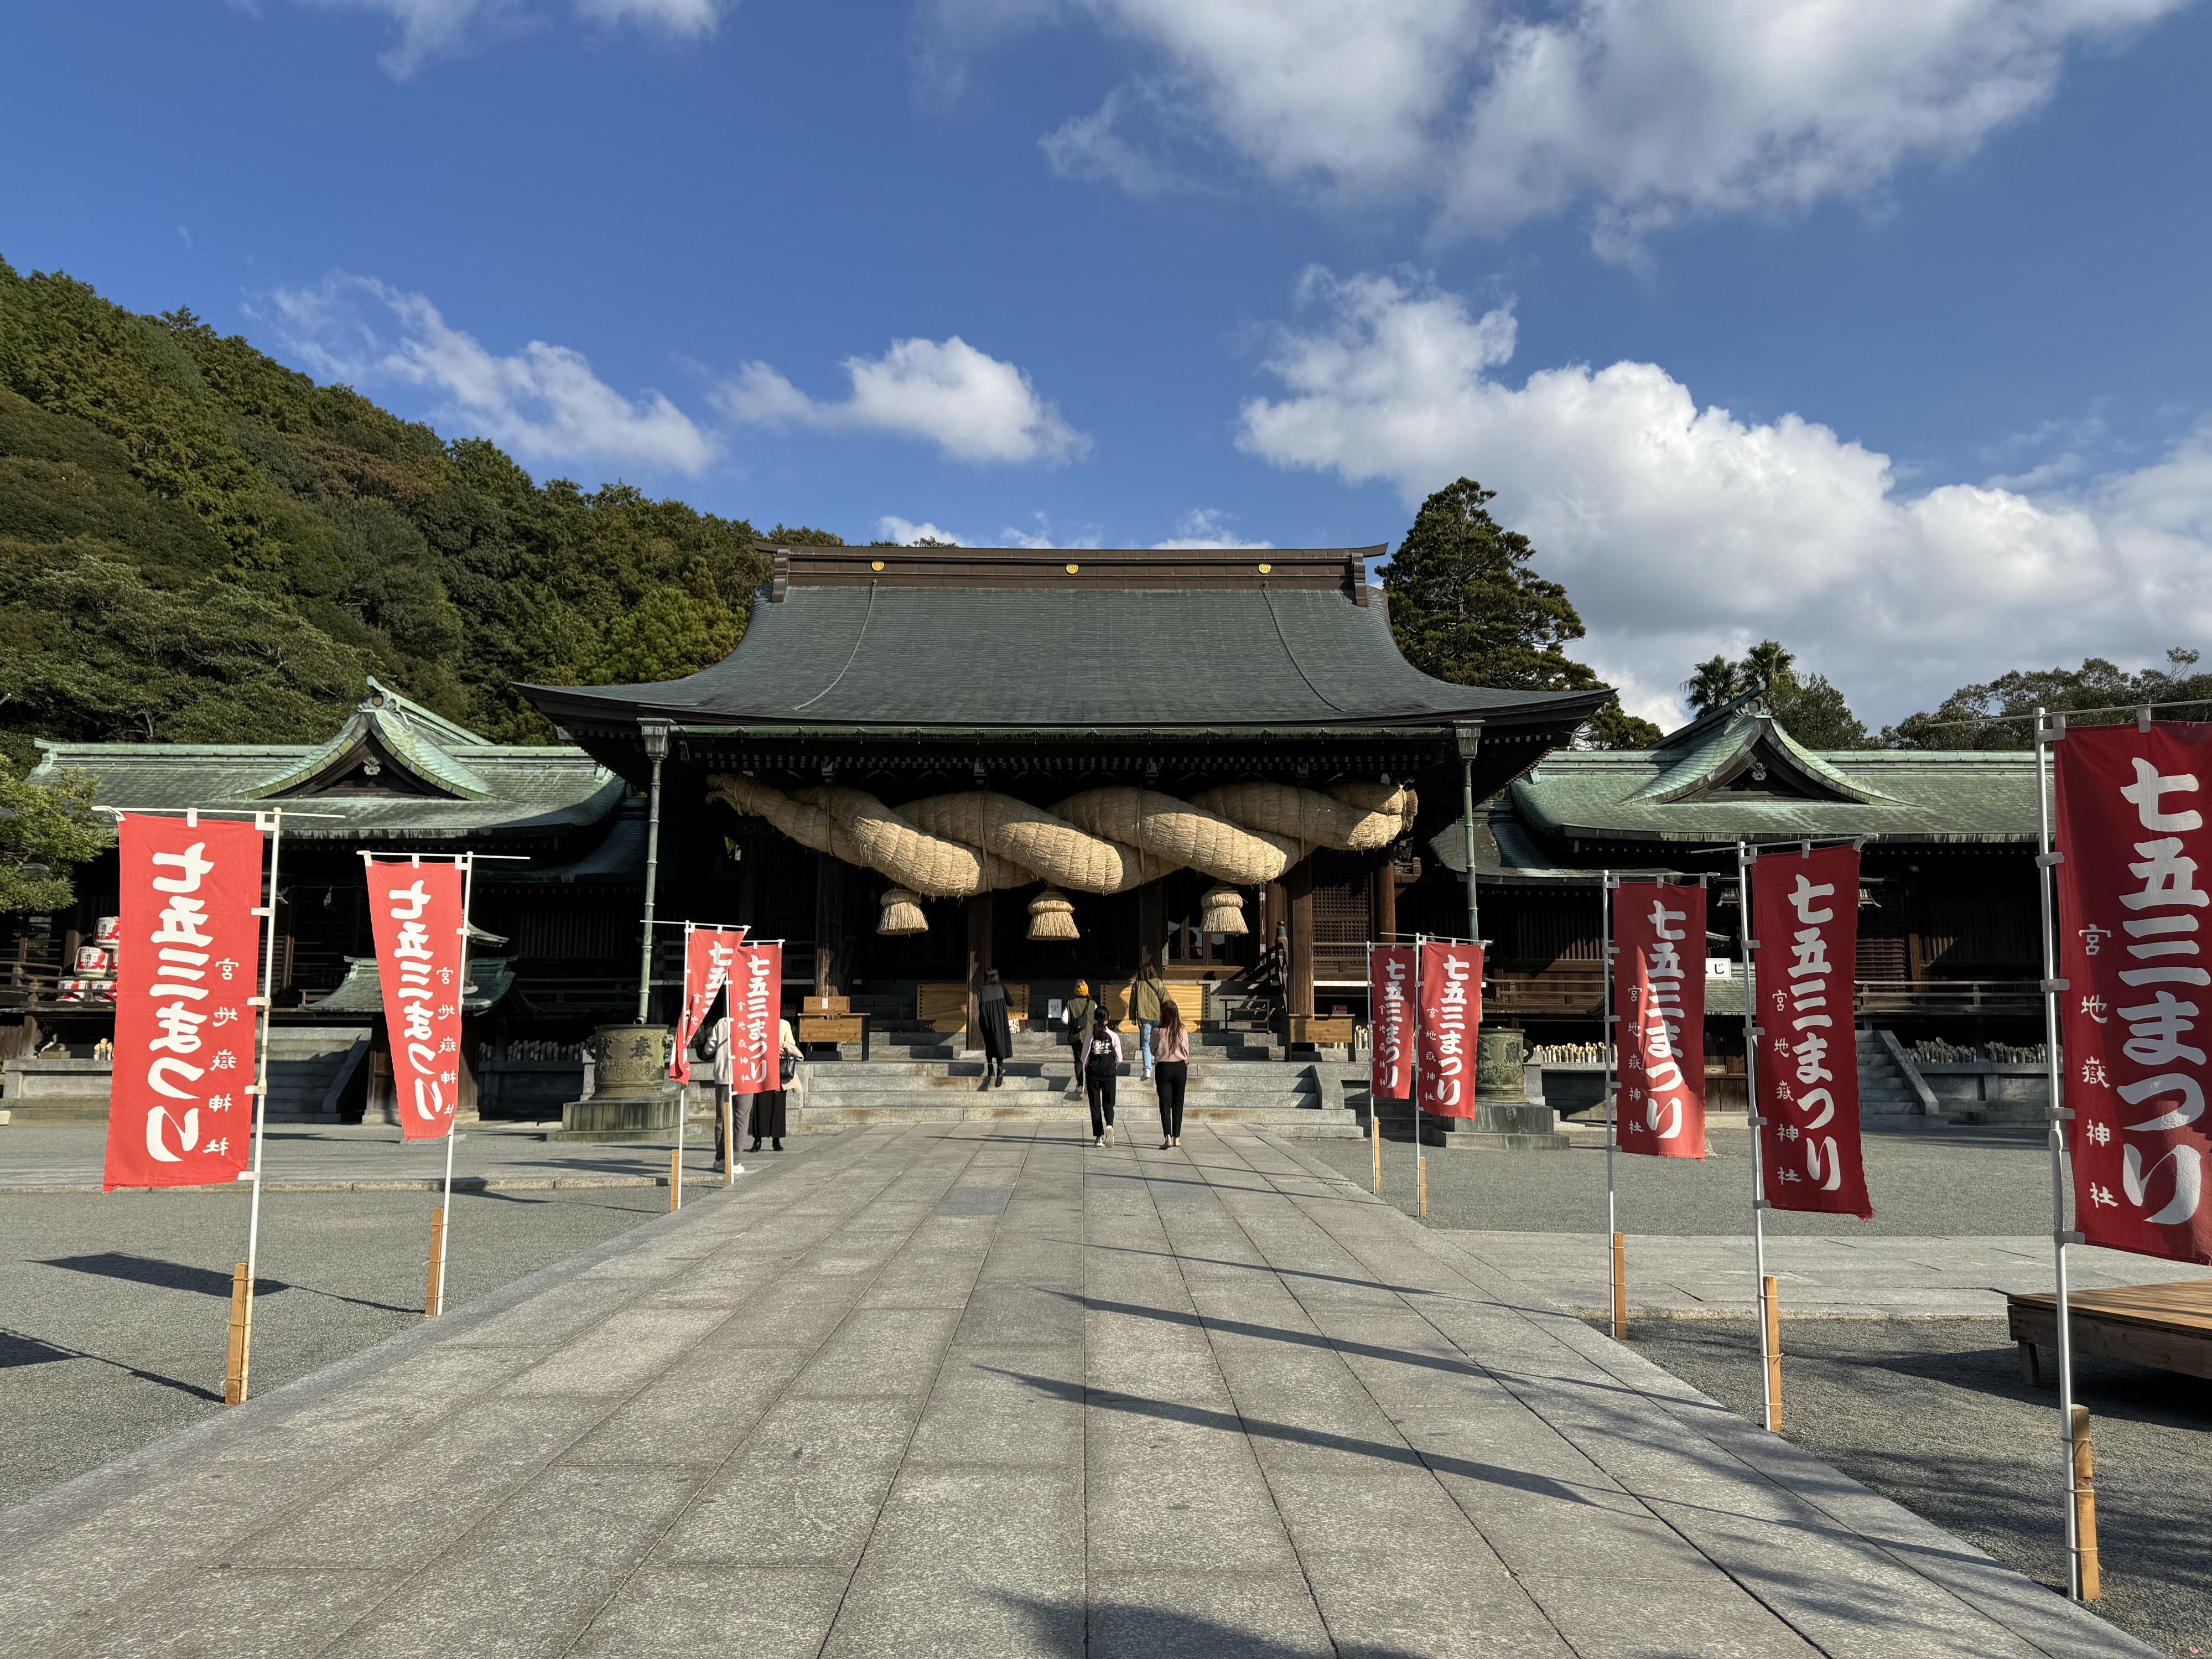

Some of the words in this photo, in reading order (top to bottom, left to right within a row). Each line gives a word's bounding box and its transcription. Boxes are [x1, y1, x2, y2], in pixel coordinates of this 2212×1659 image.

[746, 954, 770, 1083] 七五三まつり
[1384, 957, 1405, 1088] 七五三まつり
[1425, 1007, 1439, 1101] 宮地嶽神社
[1437, 953, 1470, 1106] 七五三まつり
[1627, 985, 1643, 1134] 宮地嶽神社
[1644, 899, 1687, 1139] 七五三まつり
[1787, 874, 1842, 1190] 七五三まつり
[2078, 924, 2118, 1209] 宮地嶽神社
[2116, 757, 2211, 1225] 七五三まつり
[1772, 989, 1801, 1185] 宮地嶽神社
